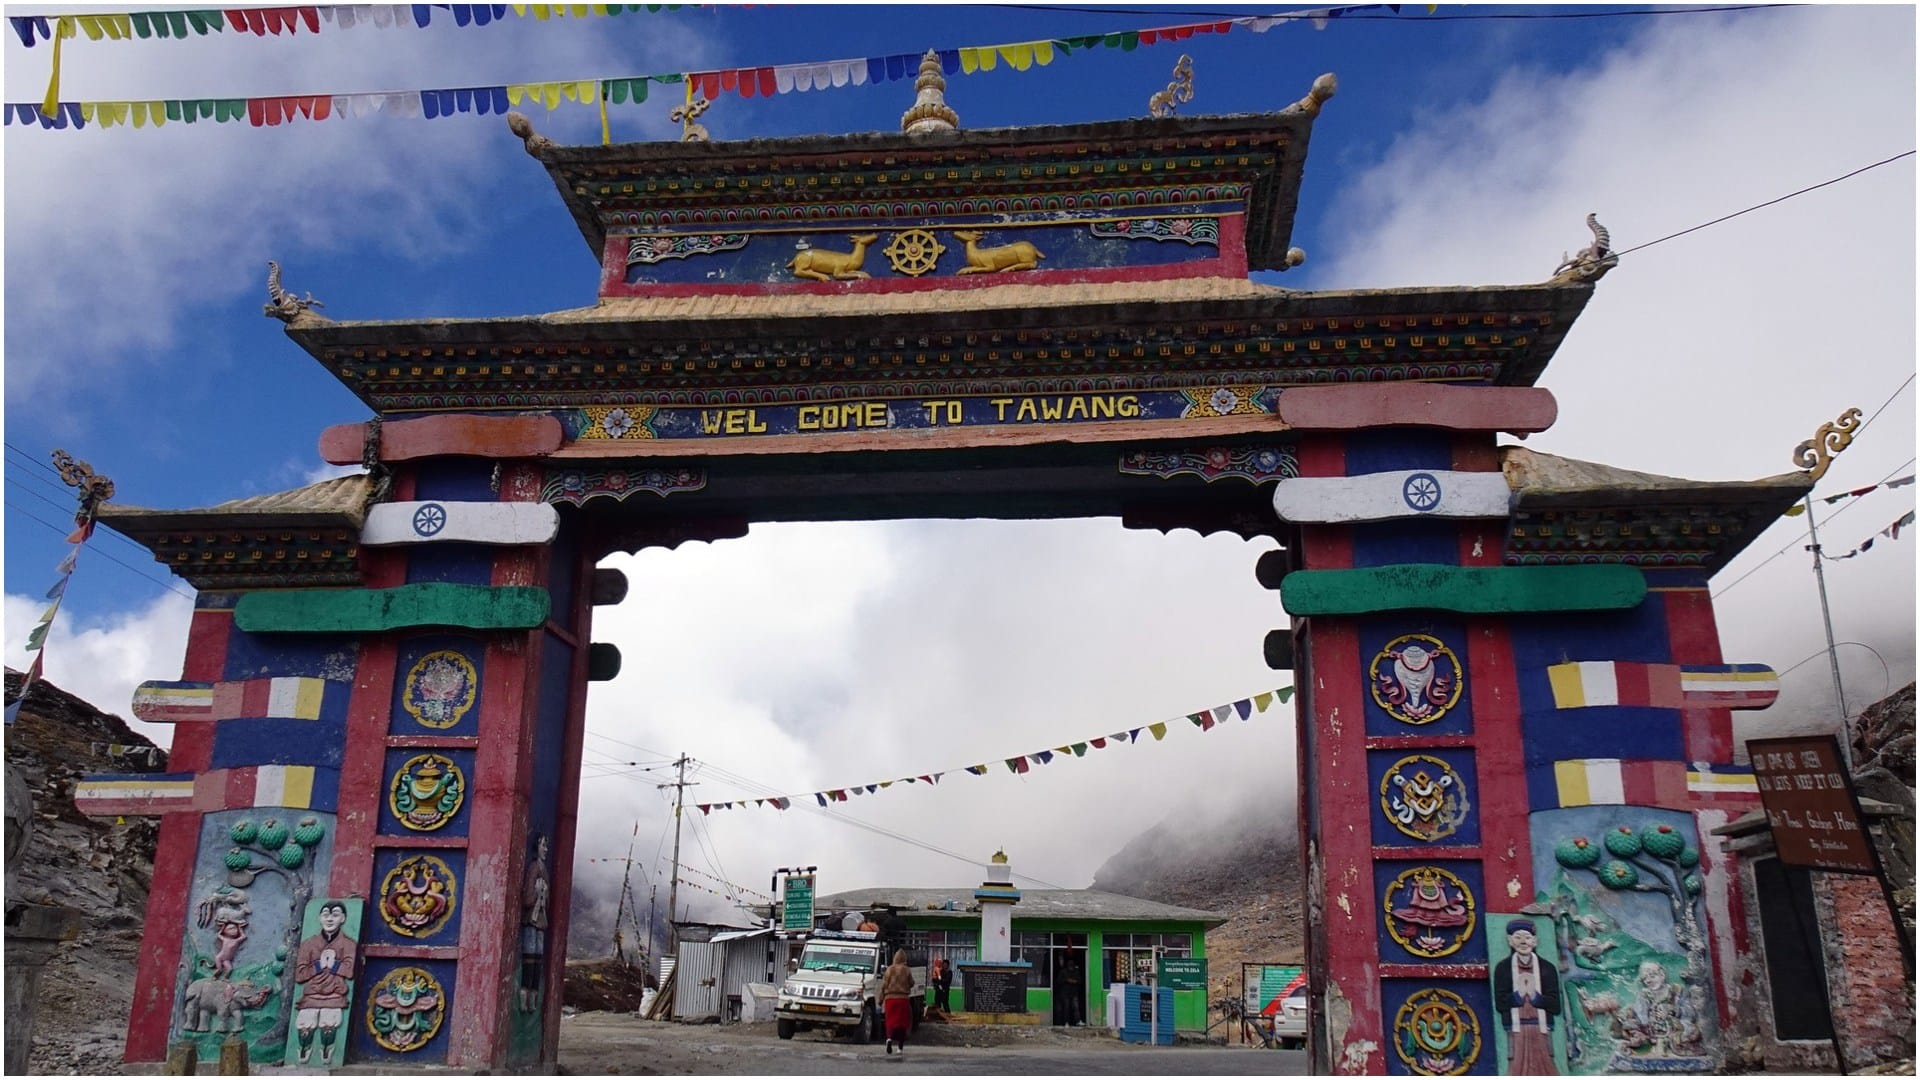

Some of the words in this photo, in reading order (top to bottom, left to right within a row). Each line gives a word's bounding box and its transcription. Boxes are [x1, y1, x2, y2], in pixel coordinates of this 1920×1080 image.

[702, 409, 767, 435] WEL
[799, 402, 887, 430] COME
[922, 400, 962, 425] TO
[990, 395, 1140, 421] TAWANG
